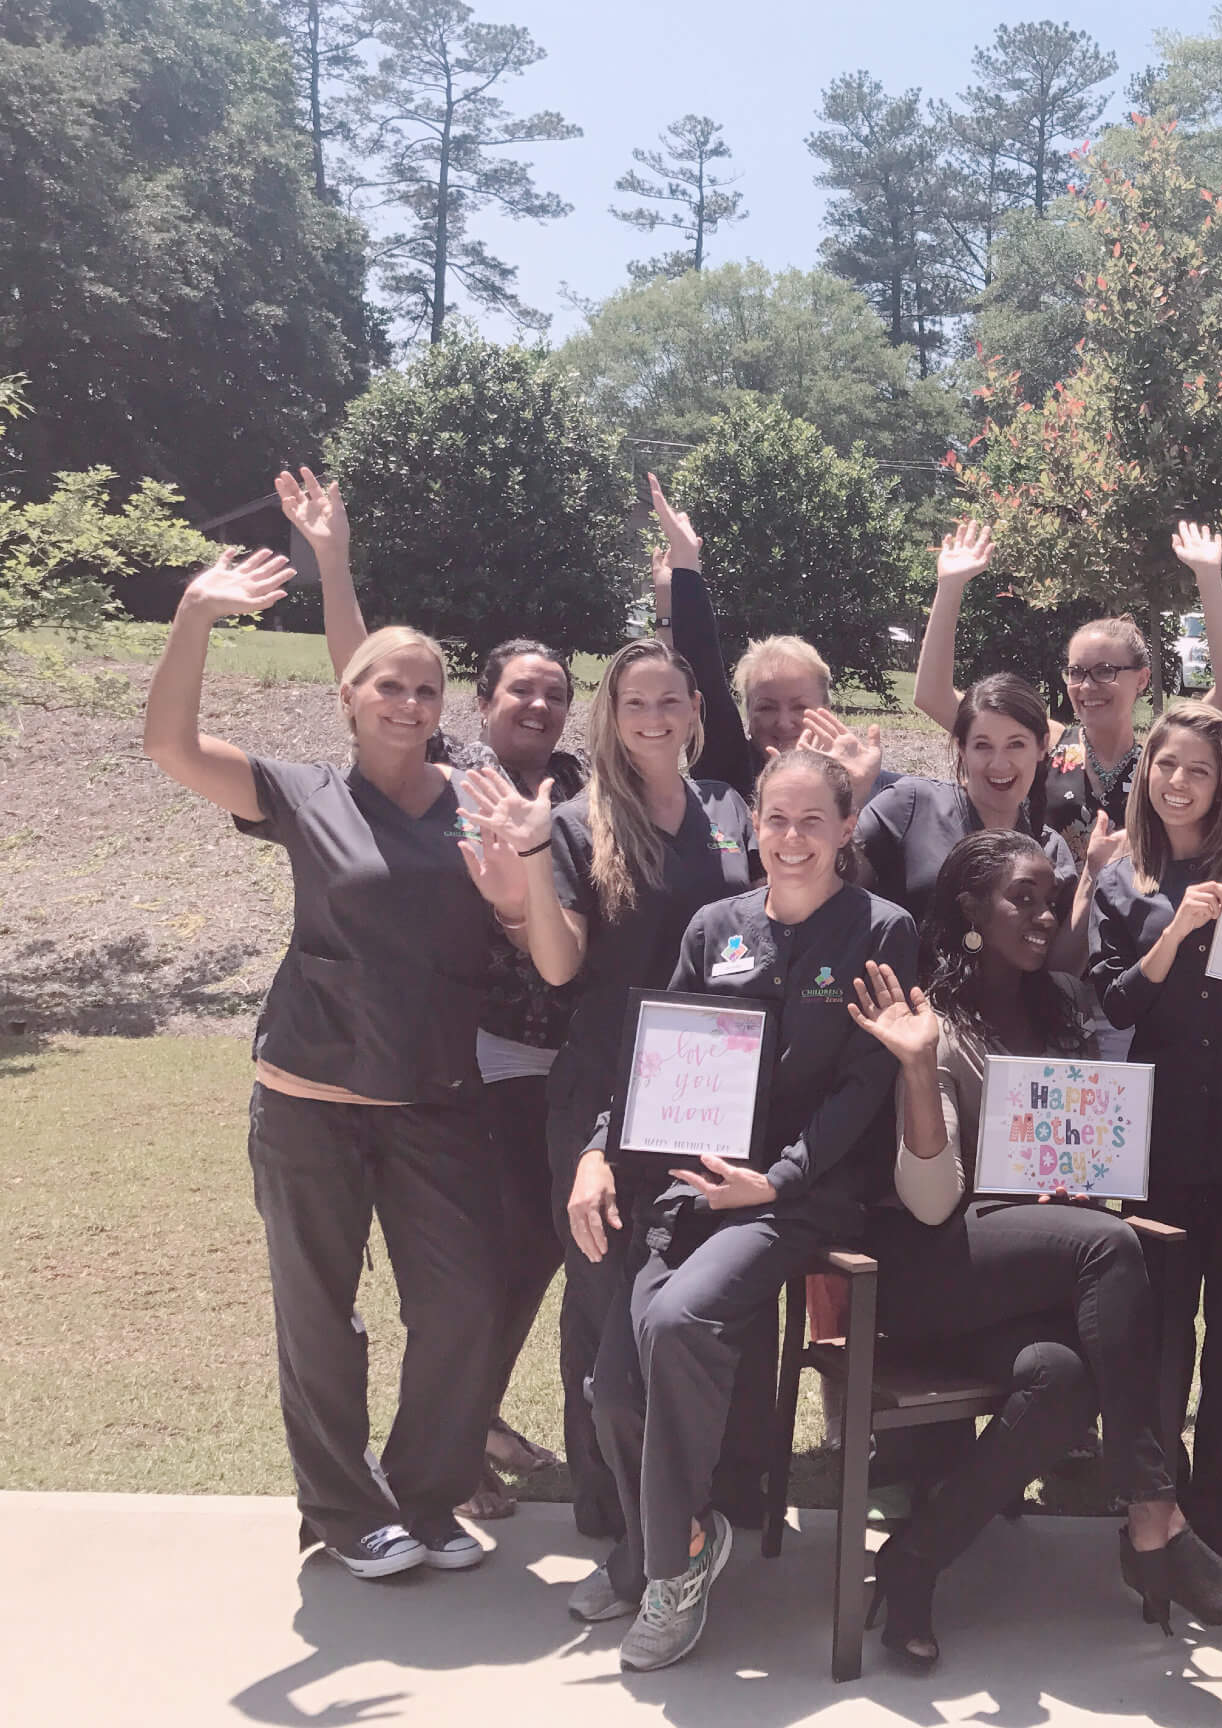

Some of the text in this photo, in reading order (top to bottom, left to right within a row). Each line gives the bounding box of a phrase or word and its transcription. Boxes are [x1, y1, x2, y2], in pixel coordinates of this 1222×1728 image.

[672, 1072, 721, 1101] you
[1030, 1082, 1110, 1115] Happy
[661, 1105, 723, 1126] mom
[1039, 1144, 1087, 1184] Day
